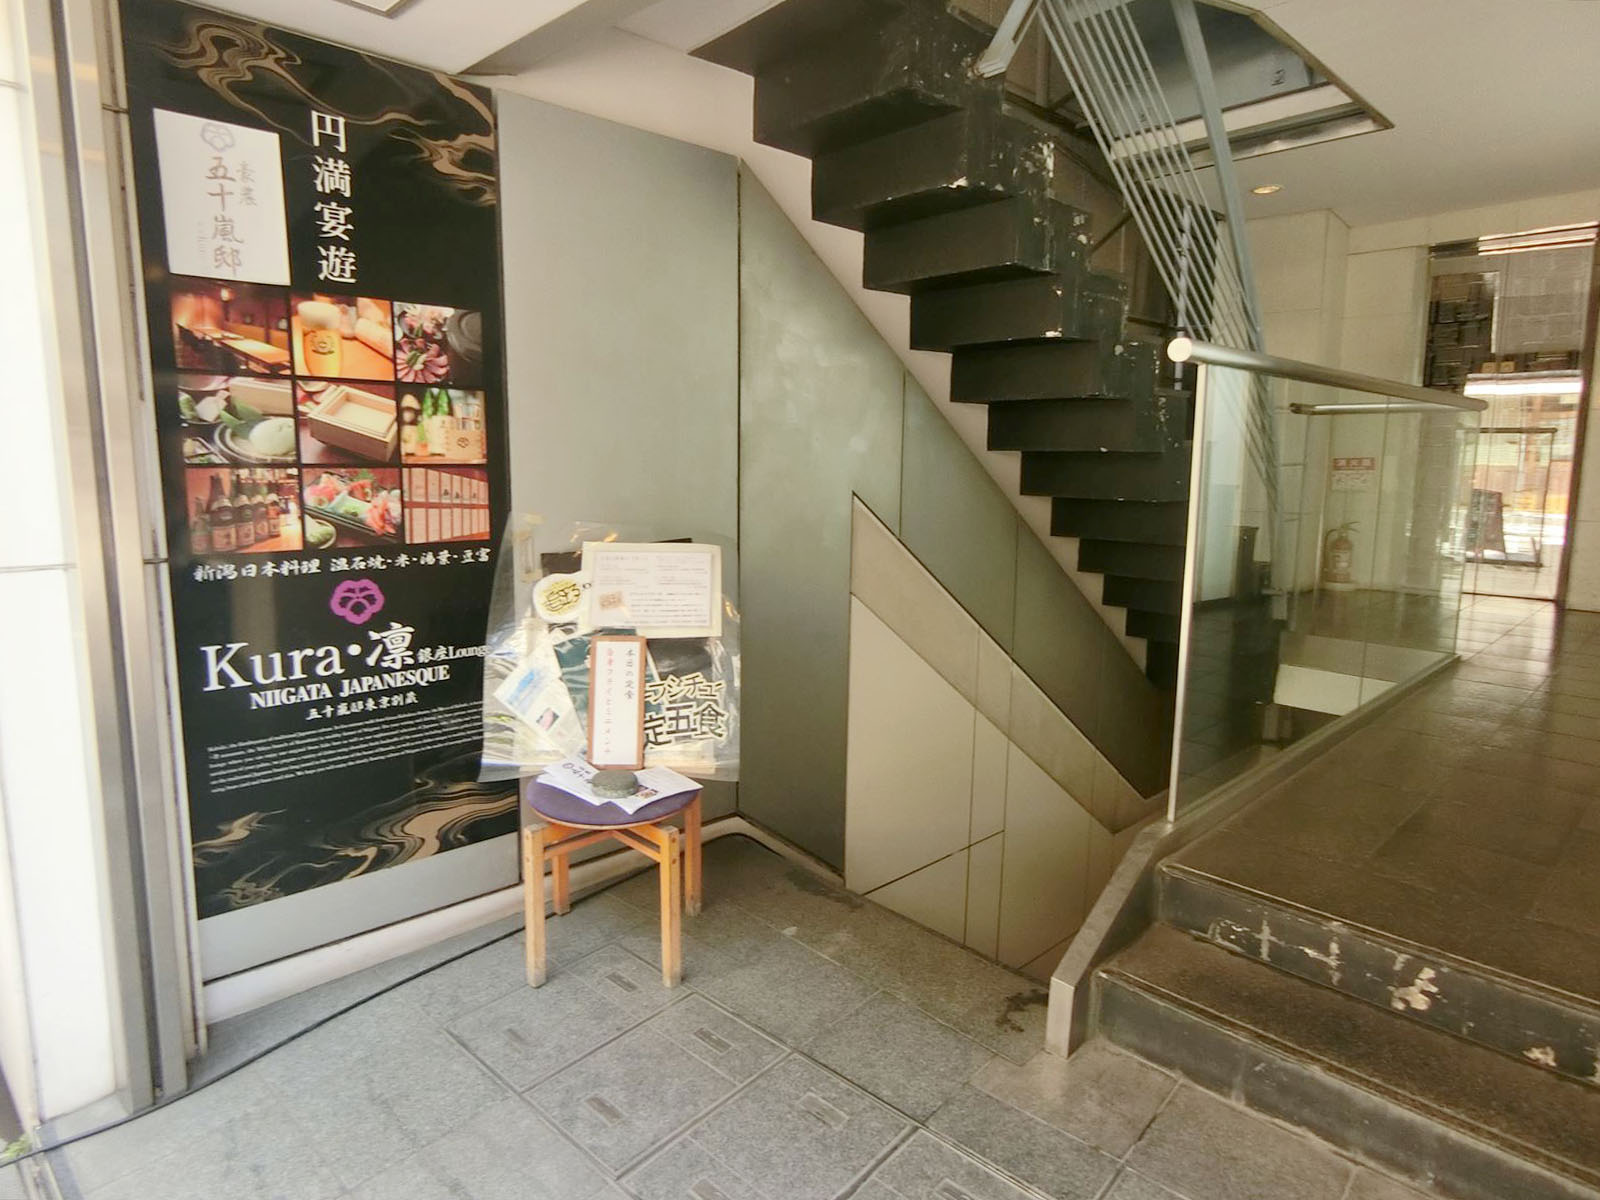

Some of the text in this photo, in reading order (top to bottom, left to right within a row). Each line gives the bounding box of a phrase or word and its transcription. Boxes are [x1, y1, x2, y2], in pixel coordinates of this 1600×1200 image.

[205, 156, 244, 277] 五十嵐邸
[311, 110, 357, 284] 円満宴遊
[193, 558, 322, 582] 新潟日本料理
[249, 664, 451, 710] NIIGATA JAPANESQUE
